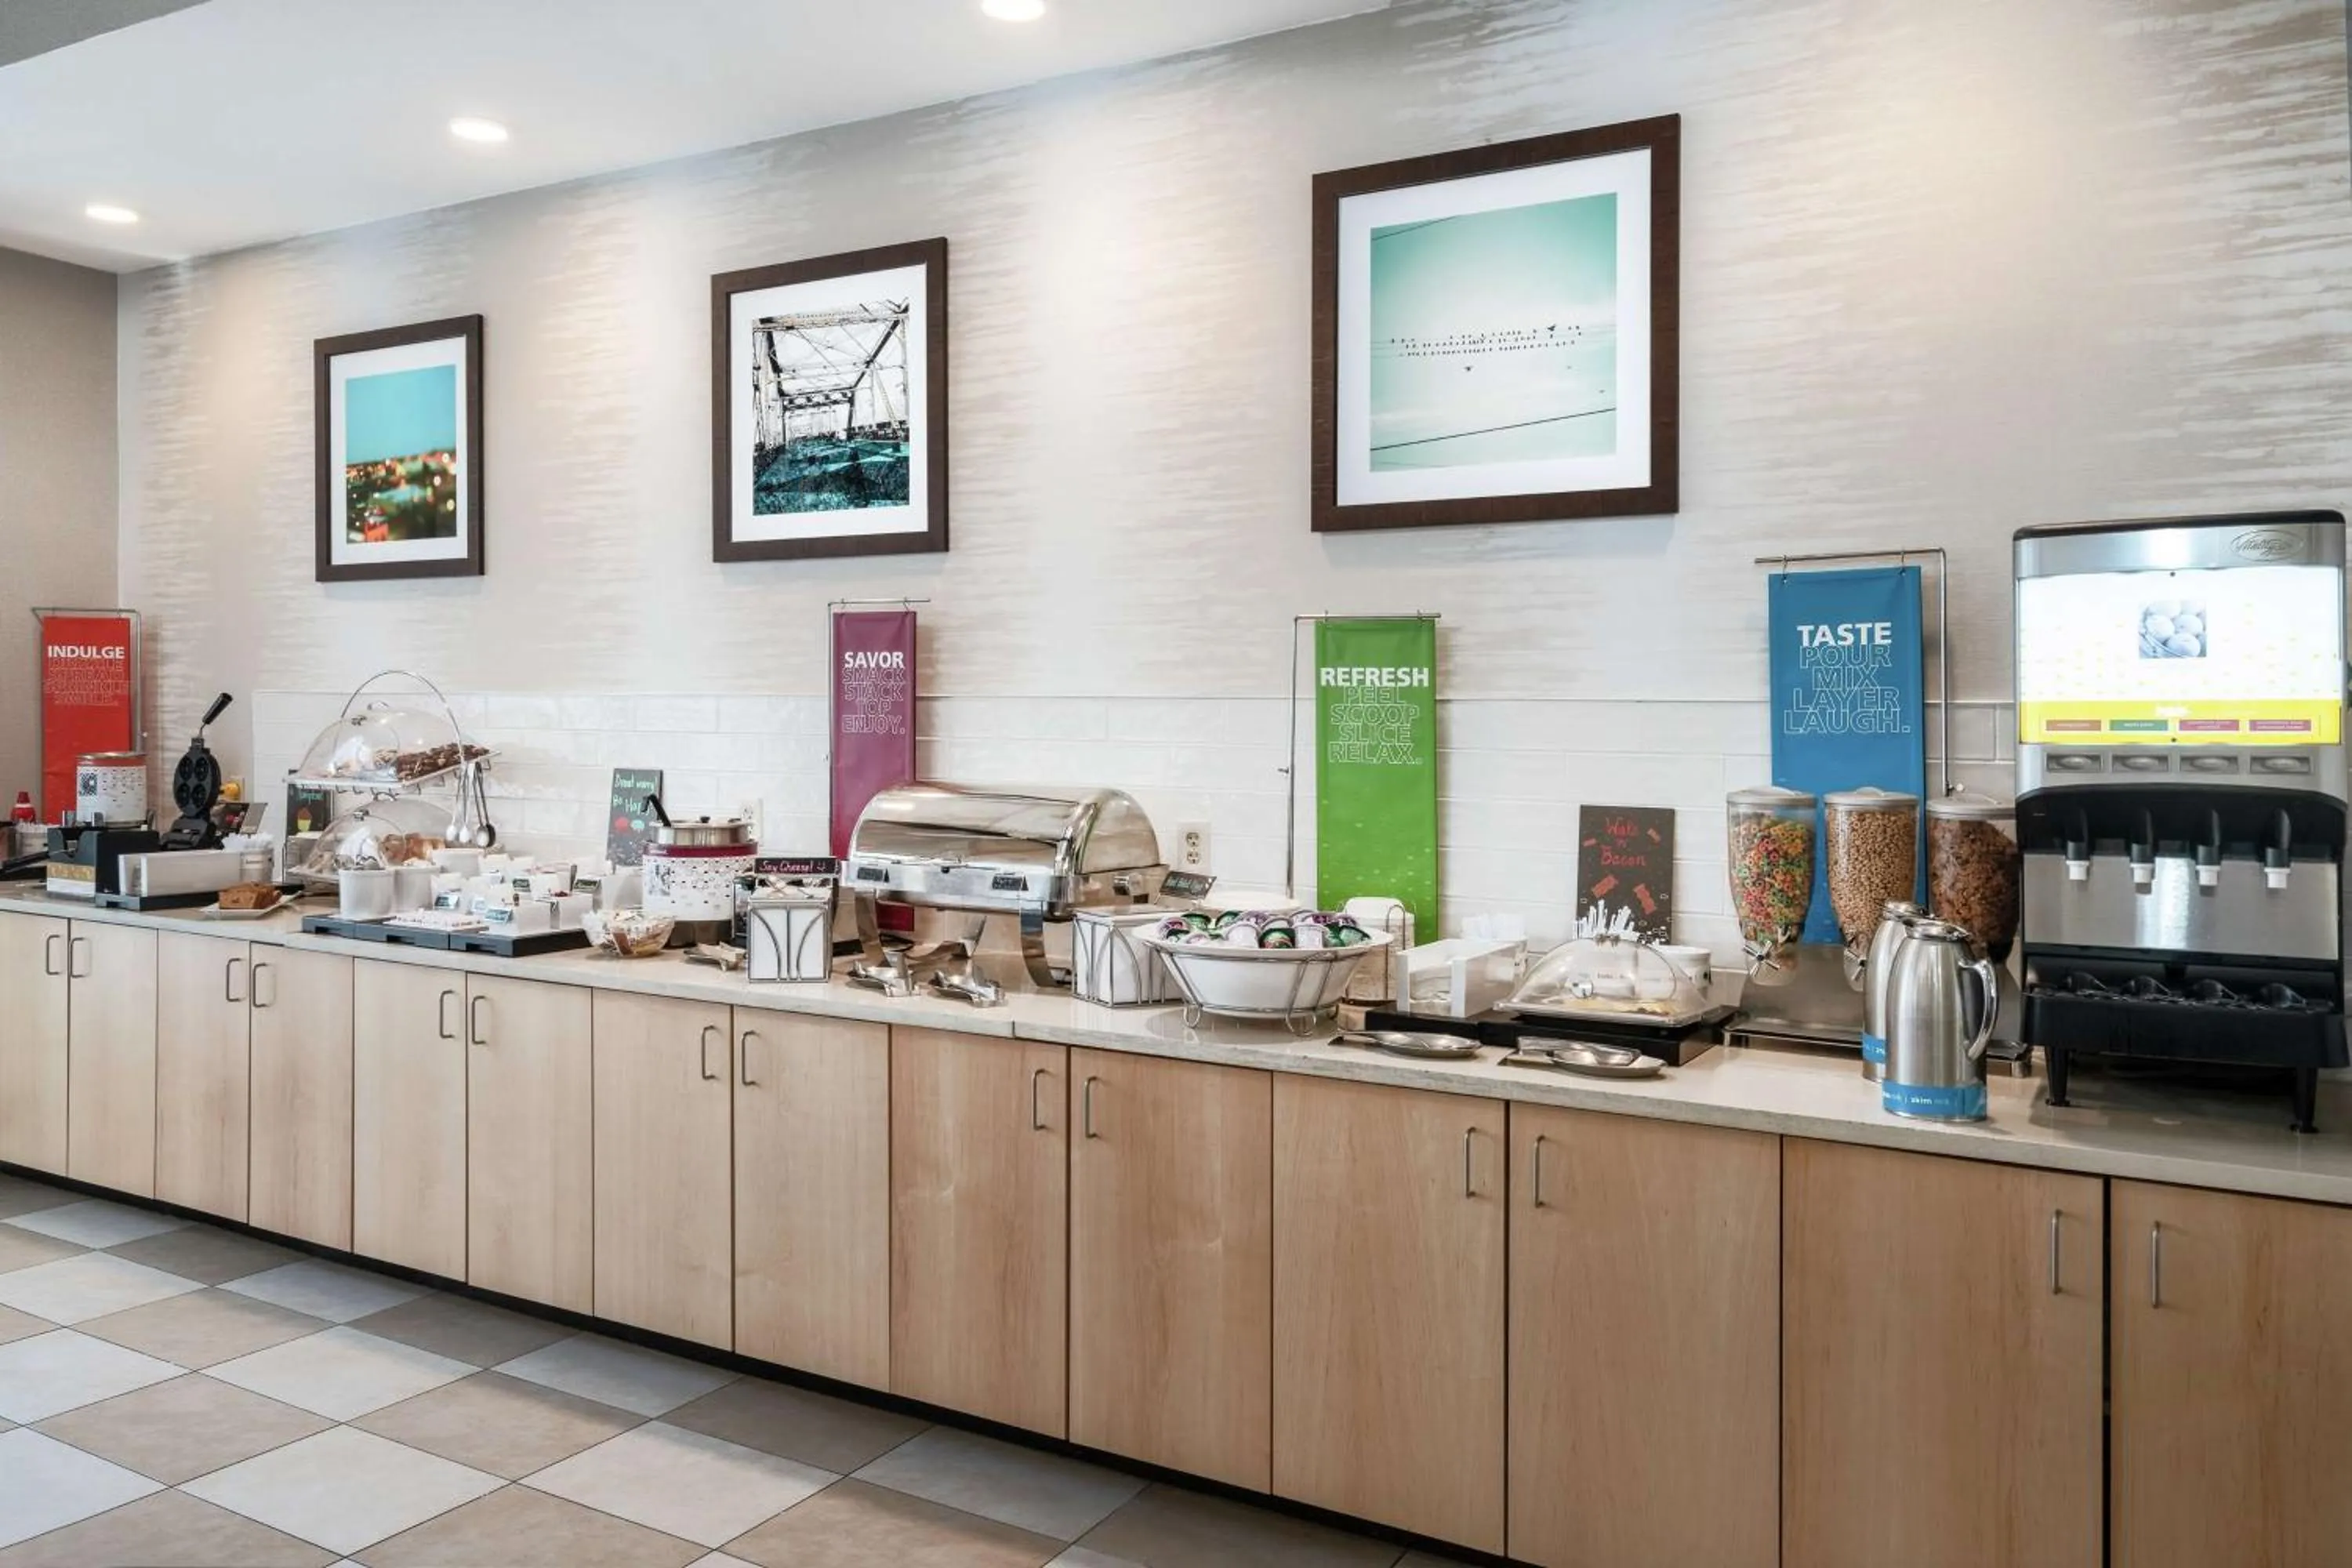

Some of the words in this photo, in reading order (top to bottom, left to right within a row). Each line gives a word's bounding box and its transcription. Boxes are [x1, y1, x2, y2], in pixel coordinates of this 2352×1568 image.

[1796, 622, 1893, 647] TASTE
[48, 645, 125, 659] INDULGE
[844, 652, 905, 669] SAVOR
[1799, 642, 1893, 669] POUR
[842, 666, 906, 684] SMACK
[1320, 667, 1429, 687] REFRESH
[1812, 664, 1880, 690] MIX
[844, 681, 904, 701] STACK
[1344, 685, 1406, 705] PEEL
[1793, 686, 1901, 712] LAYER
[855, 698, 891, 717] TOP
[1330, 703, 1420, 725] SCOOP
[841, 714, 906, 735] ENJOY.
[1783, 709, 1911, 735] LAUGH.
[1338, 723, 1412, 745] SLICE
[1329, 742, 1423, 764] RELAX.
